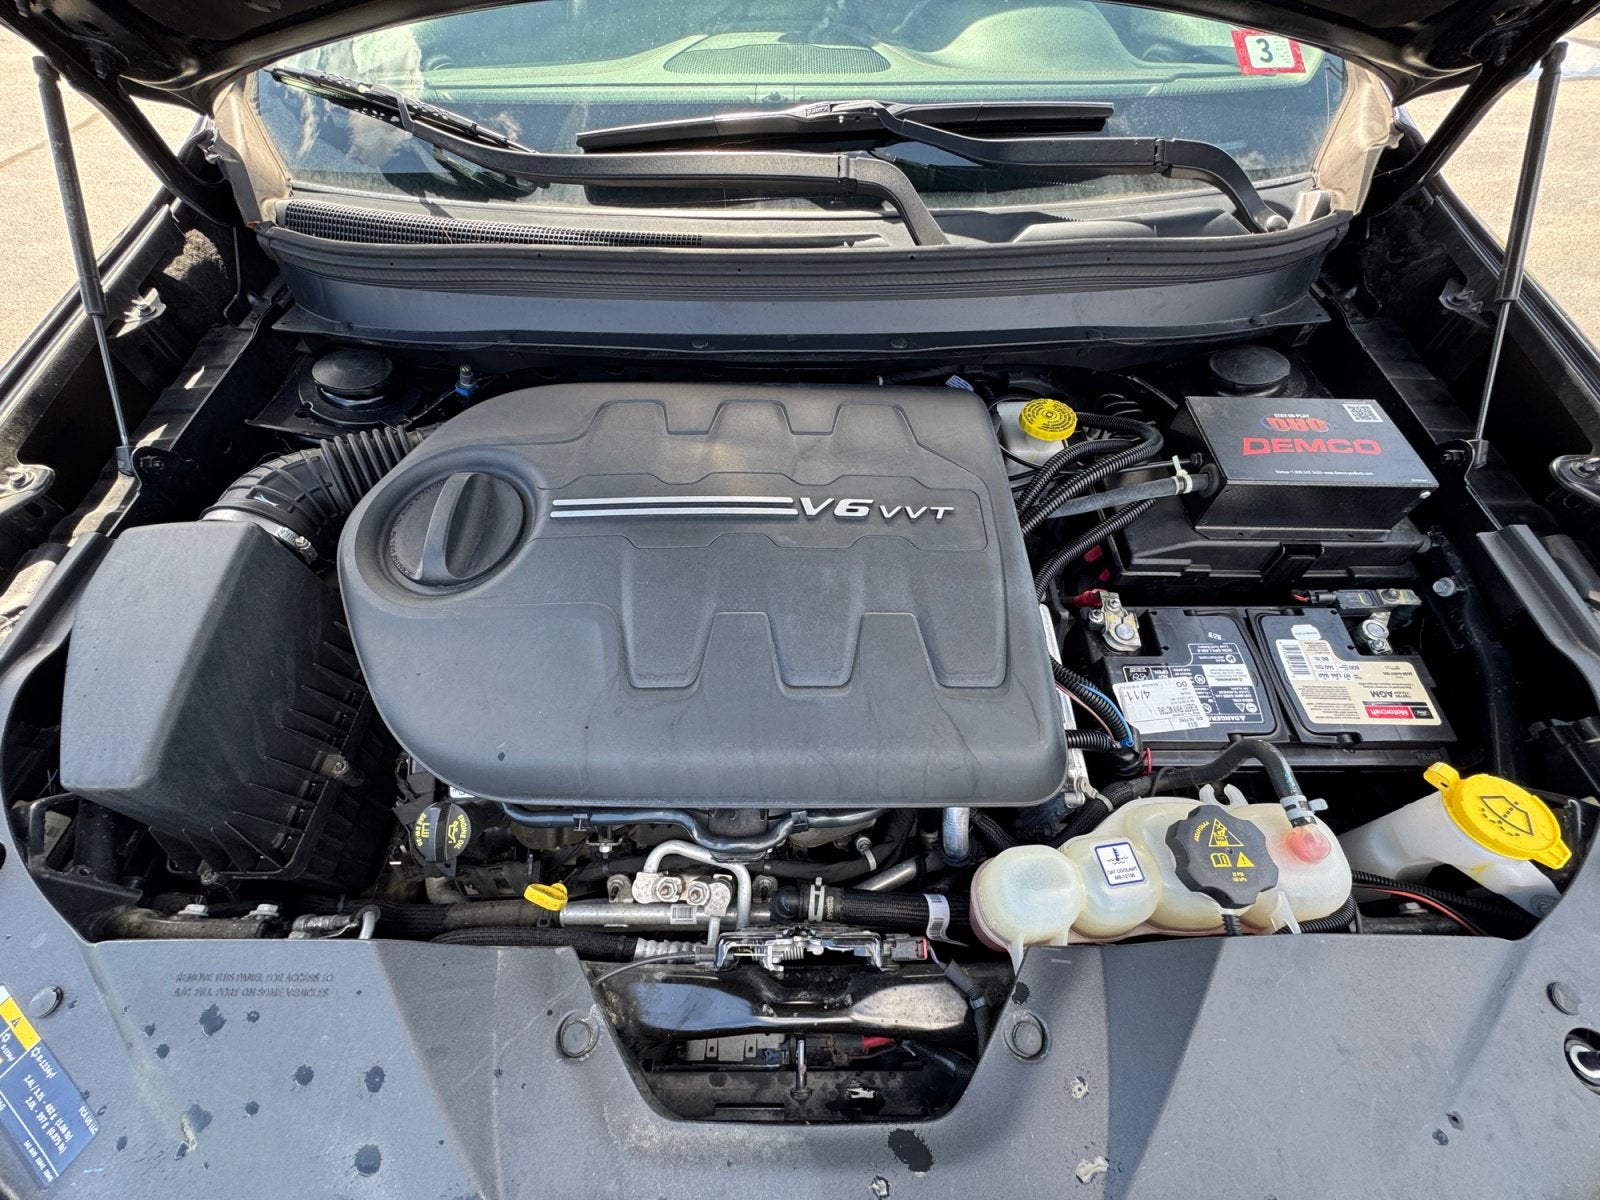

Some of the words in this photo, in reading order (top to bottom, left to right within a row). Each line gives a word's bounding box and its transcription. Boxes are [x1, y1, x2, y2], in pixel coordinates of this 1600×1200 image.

[1256, 38, 1273, 63] 3
[1266, 417, 1328, 432] DUO
[1243, 437, 1381, 456] DEMCO
[800, 497, 874, 517] V6
[879, 505, 954, 520] VVT
[1369, 690, 1393, 698] AGM
[1370, 708, 1409, 716] Motorcraft
[457, 813, 468, 839] ENGINE
[453, 839, 464, 850] OIL
[265, 972, 284, 982] FOR
[284, 972, 320, 982] ACCESS
[241, 986, 256, 998] ON
[285, 986, 329, 998] VEHICLES
[34, 1054, 55, 1079] R-1234yf
[78, 1105, 89, 1117] FCA
[84, 1115, 93, 1125] US
[88, 1123, 98, 1134] LLC
